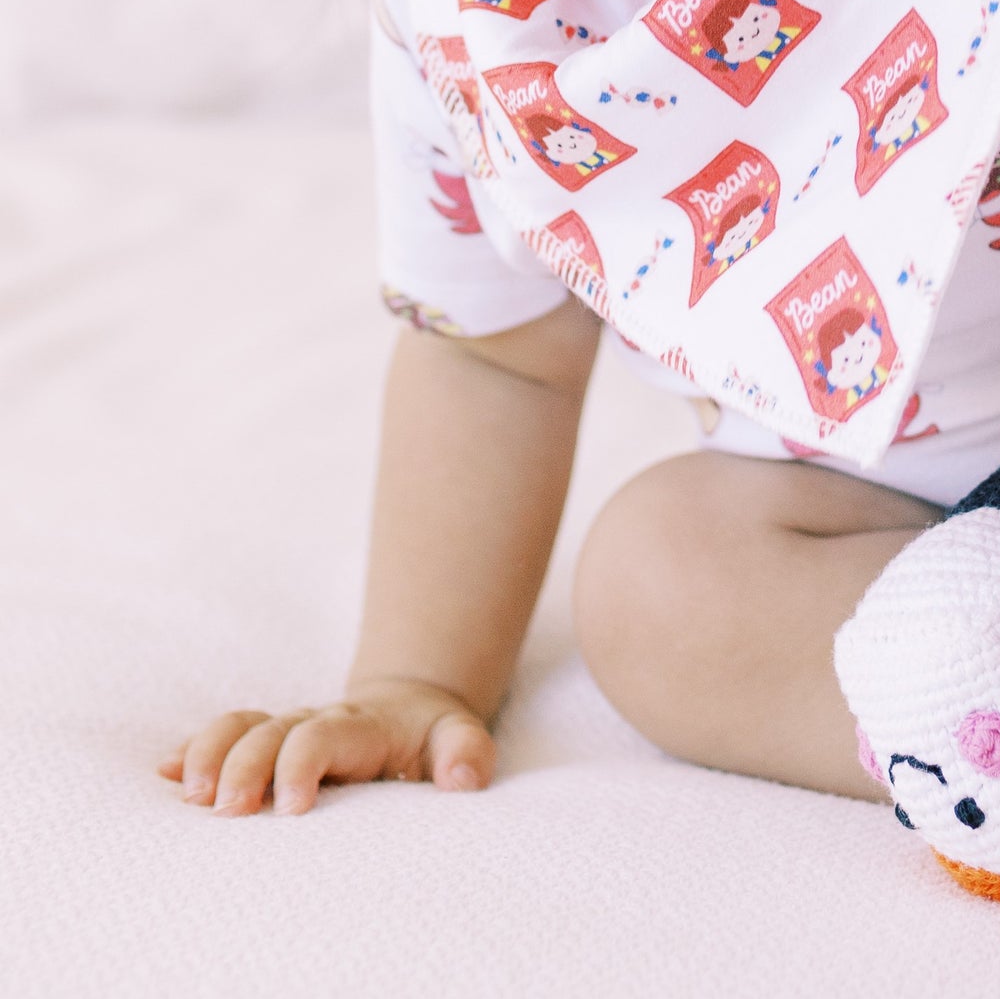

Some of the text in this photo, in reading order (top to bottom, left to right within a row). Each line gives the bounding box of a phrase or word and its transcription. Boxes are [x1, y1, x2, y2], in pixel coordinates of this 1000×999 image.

[862, 40, 928, 110] Bean
[688, 160, 762, 221] Bean
[783, 268, 858, 337] Bean
